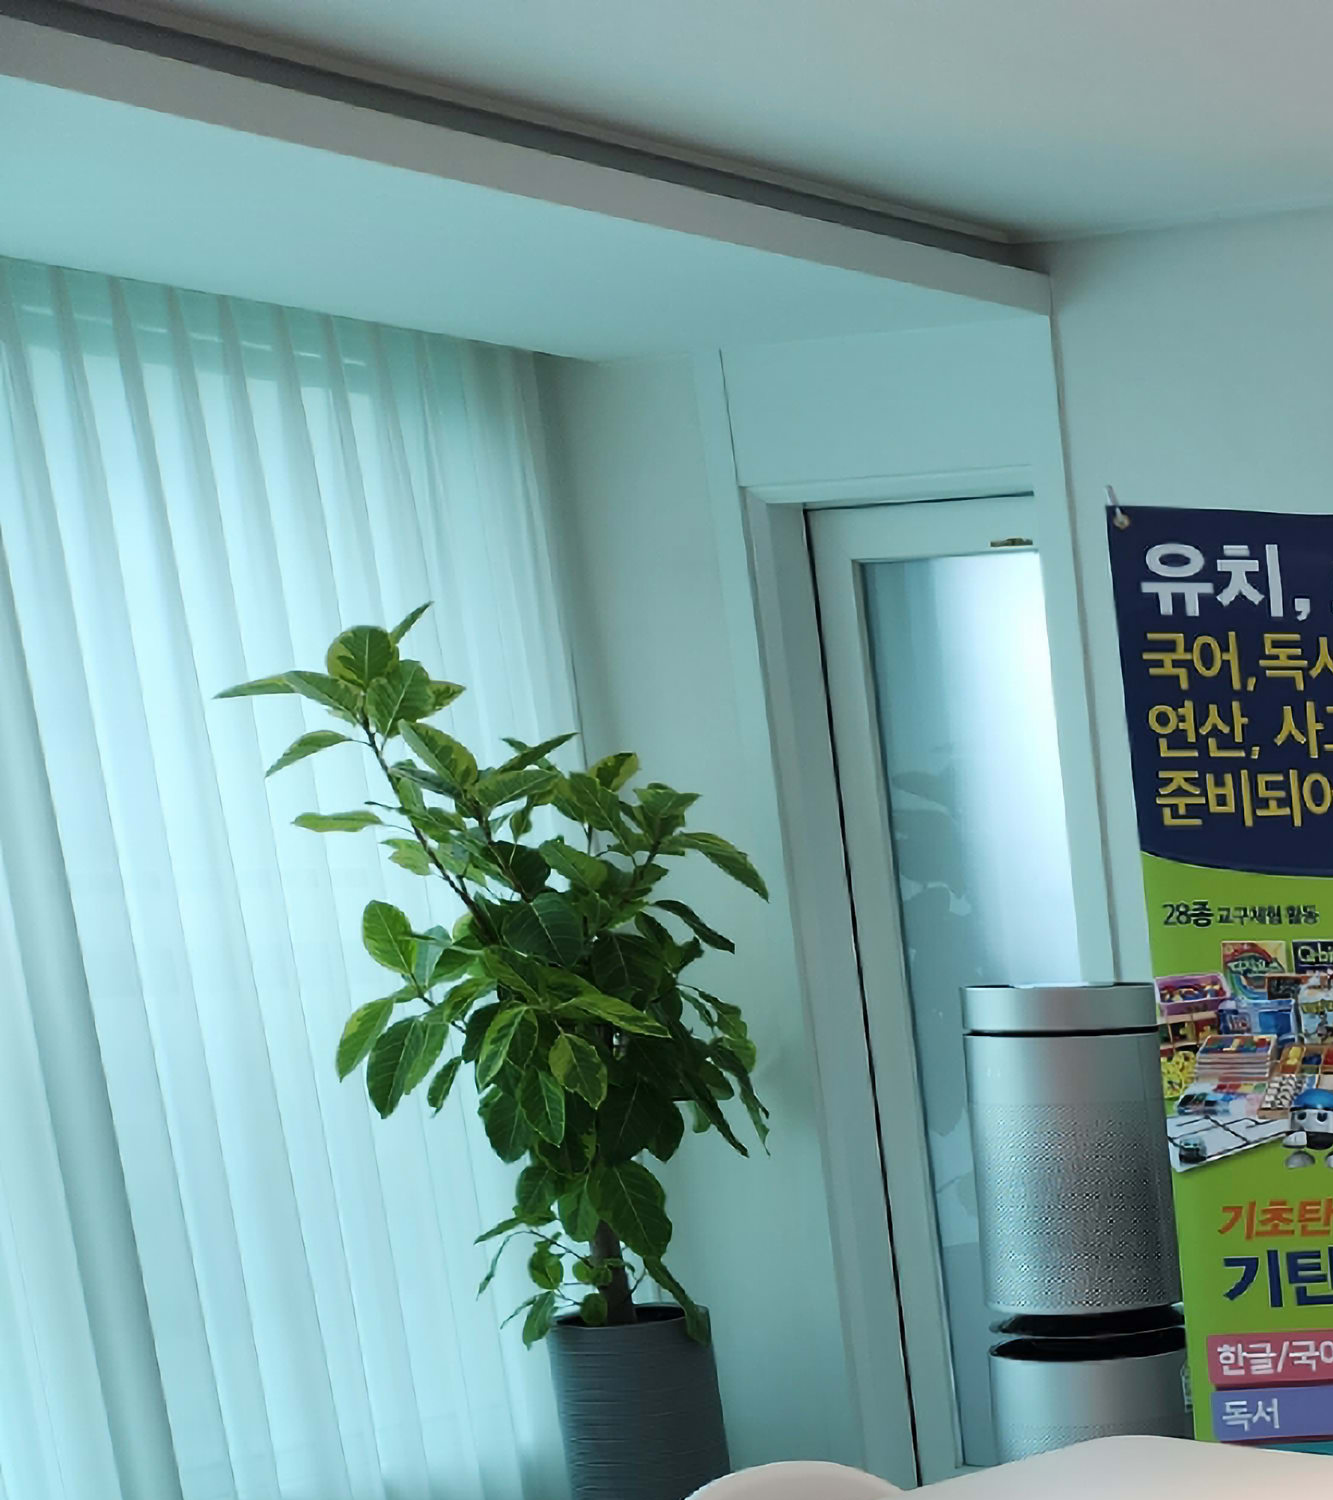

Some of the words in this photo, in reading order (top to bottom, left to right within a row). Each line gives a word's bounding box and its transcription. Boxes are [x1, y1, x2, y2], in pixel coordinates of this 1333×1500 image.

[1141, 542, 1310, 621] 유치,
[1148, 701, 1261, 761] 연산,
[1162, 900, 1215, 928] 28종
[1222, 1398, 1281, 1432] 독서
